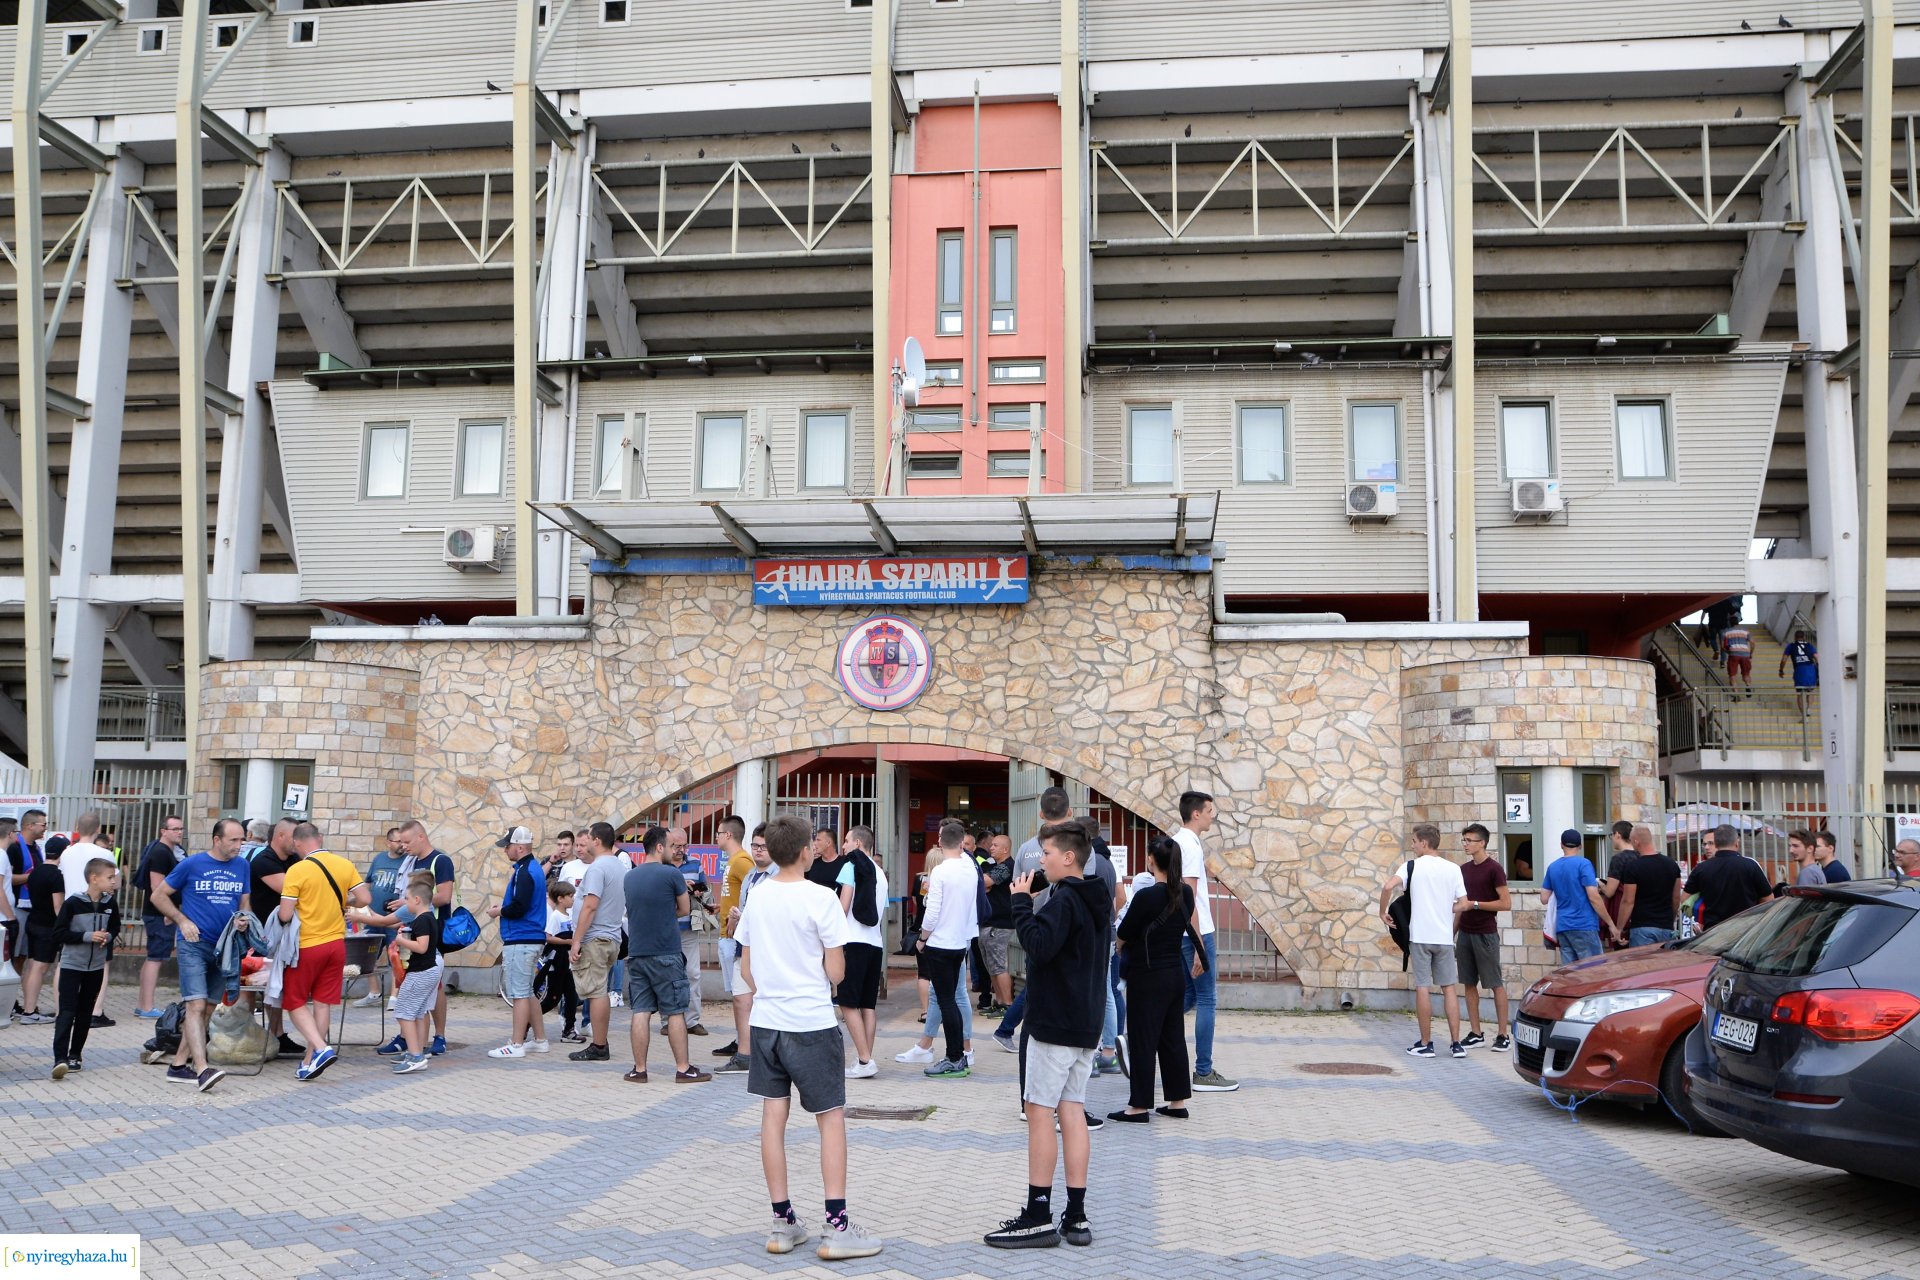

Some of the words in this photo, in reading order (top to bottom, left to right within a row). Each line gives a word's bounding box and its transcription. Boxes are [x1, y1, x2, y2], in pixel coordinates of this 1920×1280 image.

[788, 560, 874, 591] HAJRÁ
[881, 562, 988, 591] SZPARI!
[819, 591, 864, 601] NYÍREGYHÁZA
[865, 591, 904, 600] SPARTACUS
[905, 591, 938, 600] FOOTBALL
[938, 590, 957, 599] CLUB
[294, 794, 300, 805] 1
[1514, 804, 1521, 817] 2
[195, 880, 211, 891] LEE
[213, 880, 244, 893] COOPER
[1718, 1016, 1756, 1044] PEG-028
